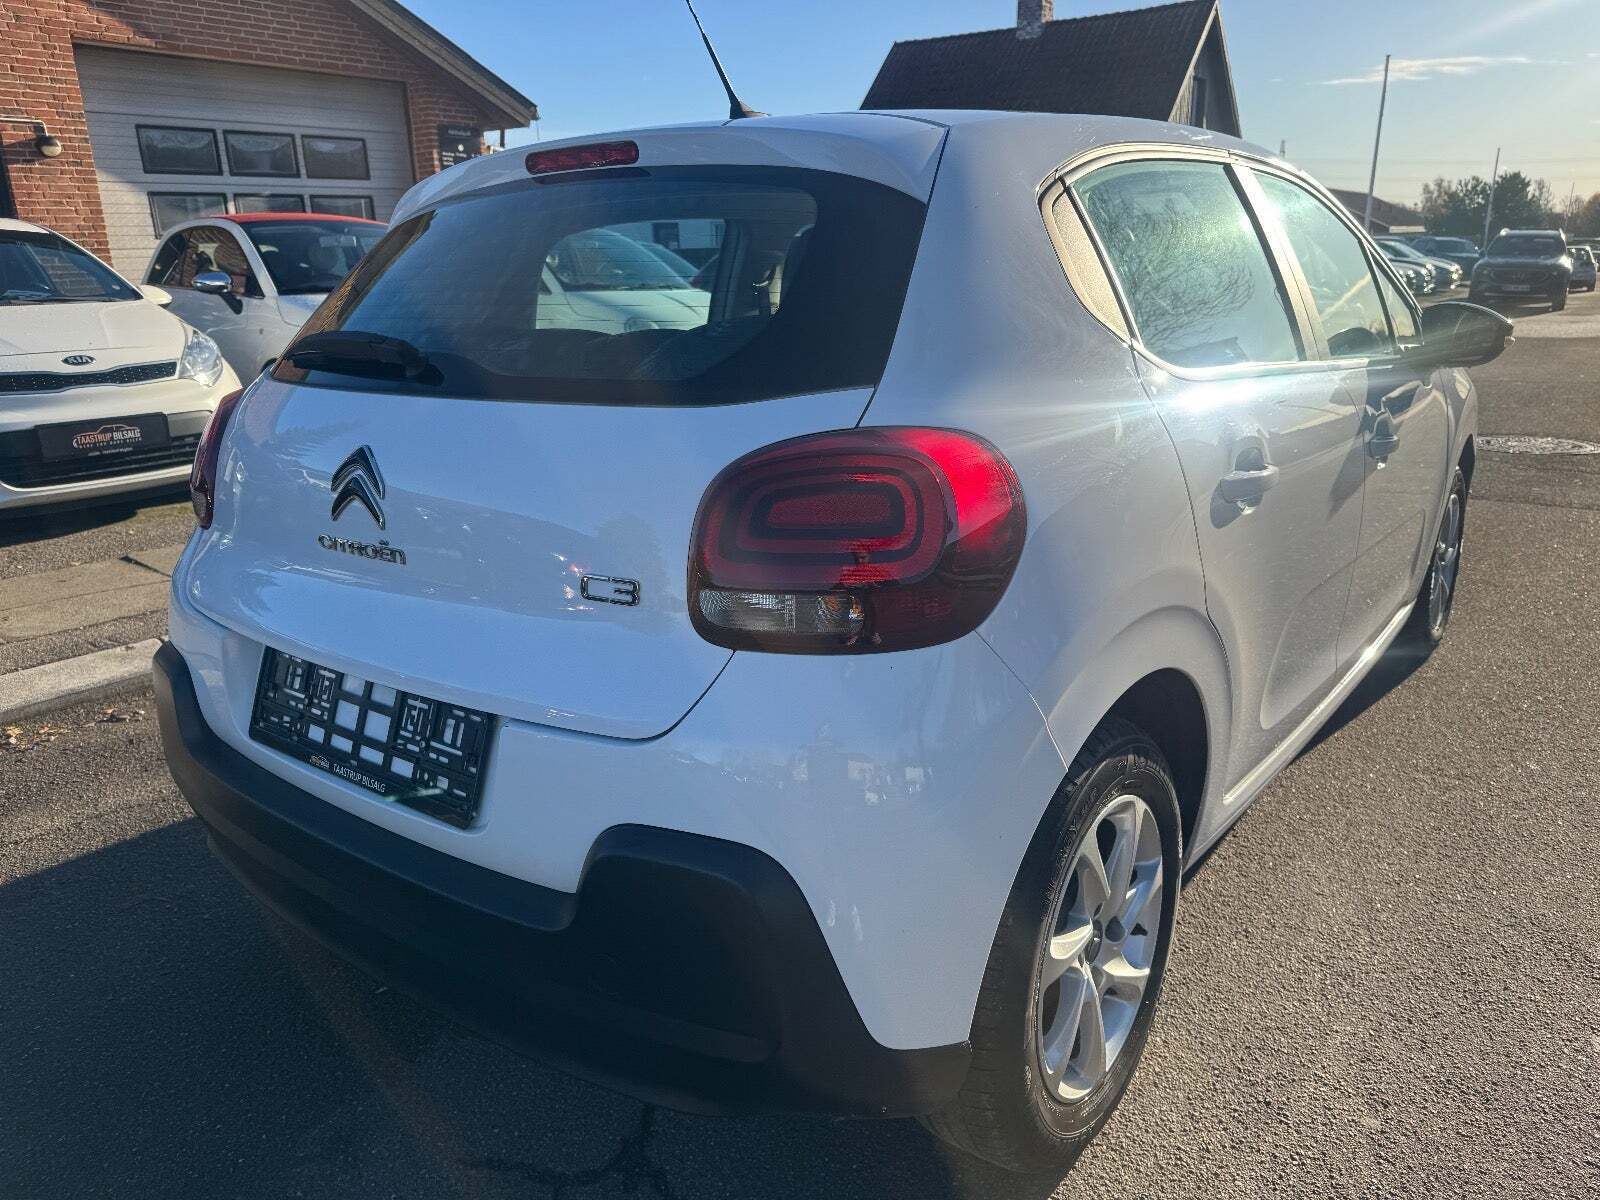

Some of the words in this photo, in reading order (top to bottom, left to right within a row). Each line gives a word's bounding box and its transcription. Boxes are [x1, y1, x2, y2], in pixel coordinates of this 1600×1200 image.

[66, 356, 93, 364] KIA
[77, 432, 112, 445] TAASTRUP
[113, 429, 141, 441] BILSALG
[581, 575, 641, 606] C3
[332, 763, 362, 781] TAASTRUP
[362, 775, 387, 793] BILSALG
